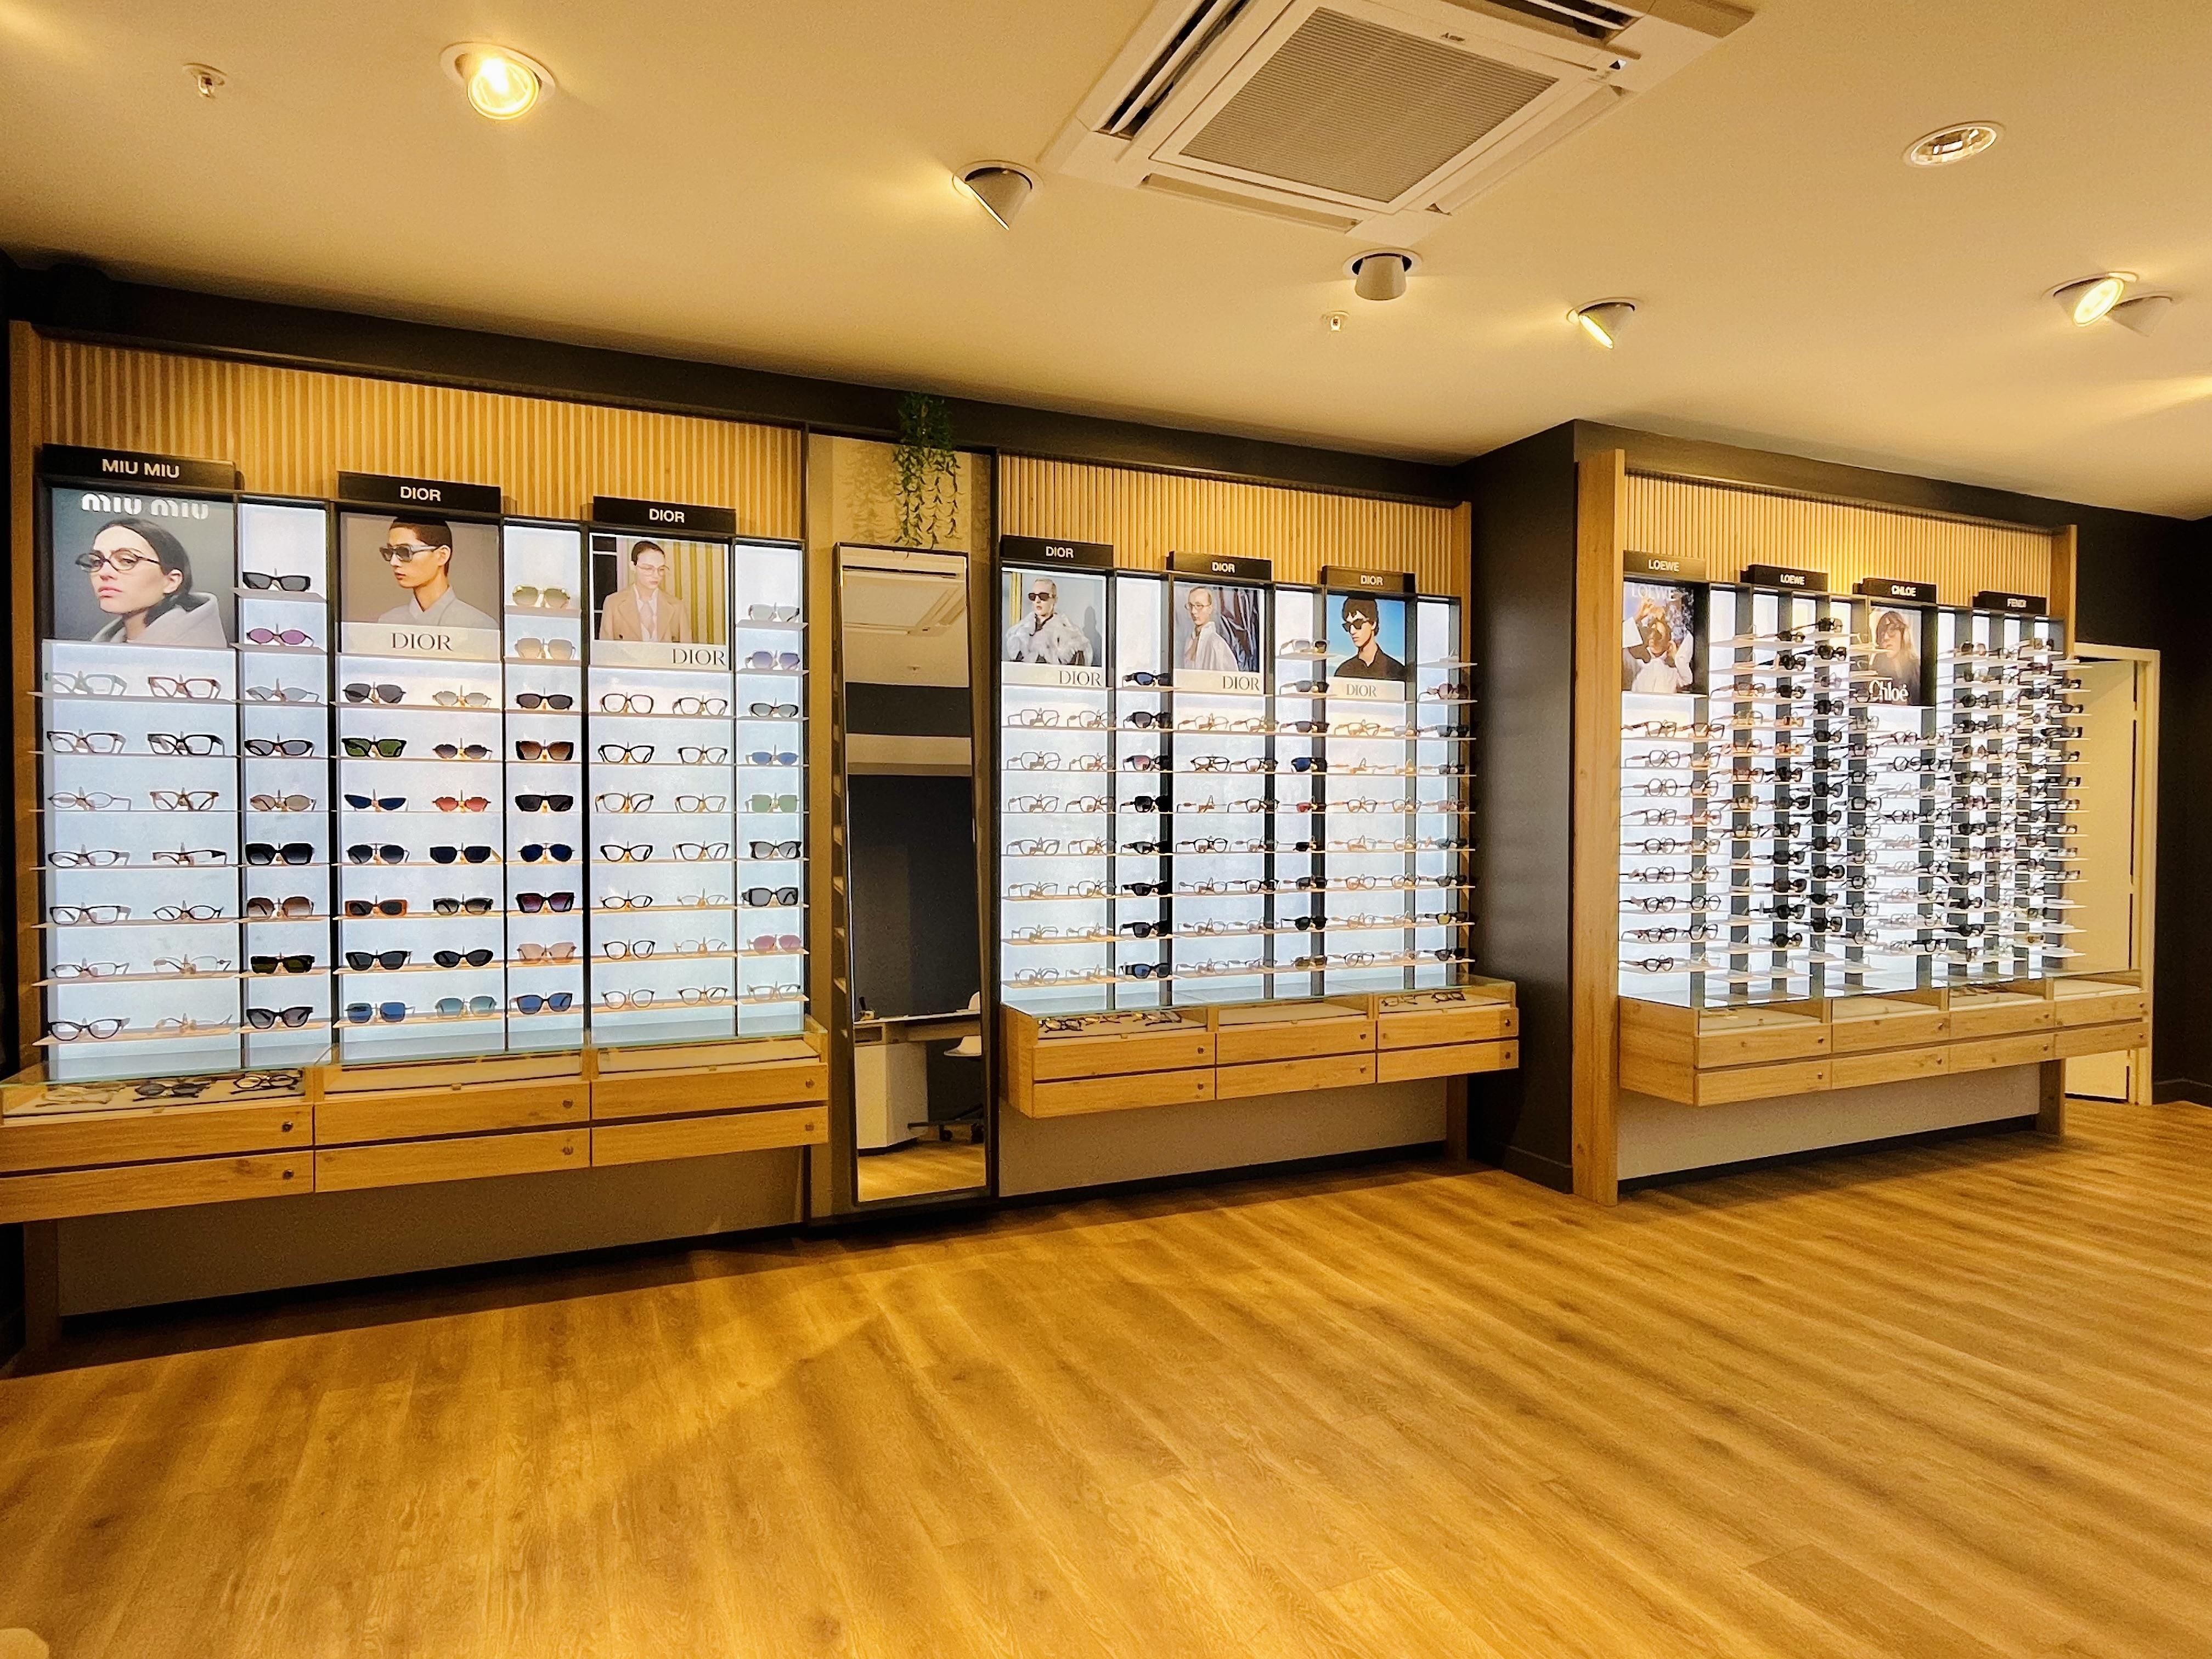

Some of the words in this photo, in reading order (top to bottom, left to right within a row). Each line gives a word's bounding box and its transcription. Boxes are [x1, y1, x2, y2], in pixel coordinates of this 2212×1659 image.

[102, 459, 138, 475] MIU
[144, 462, 180, 478] MIU
[400, 486, 441, 501] DIOR
[649, 508, 685, 523] DIOR
[1046, 546, 1074, 558] DIOR
[1211, 562, 1235, 573] DIOR
[1648, 559, 1680, 572] LOEWE
[1360, 574, 1384, 586] DIOR
[1780, 574, 1805, 585] LOEWE
[1891, 585, 1917, 597] CHLOE
[391, 632, 454, 651] DIOR
[672, 648, 726, 666] DIOR
[1059, 669, 1102, 687] DIOR
[1222, 675, 1260, 691] DIOR
[1346, 684, 1378, 697] DIOR
